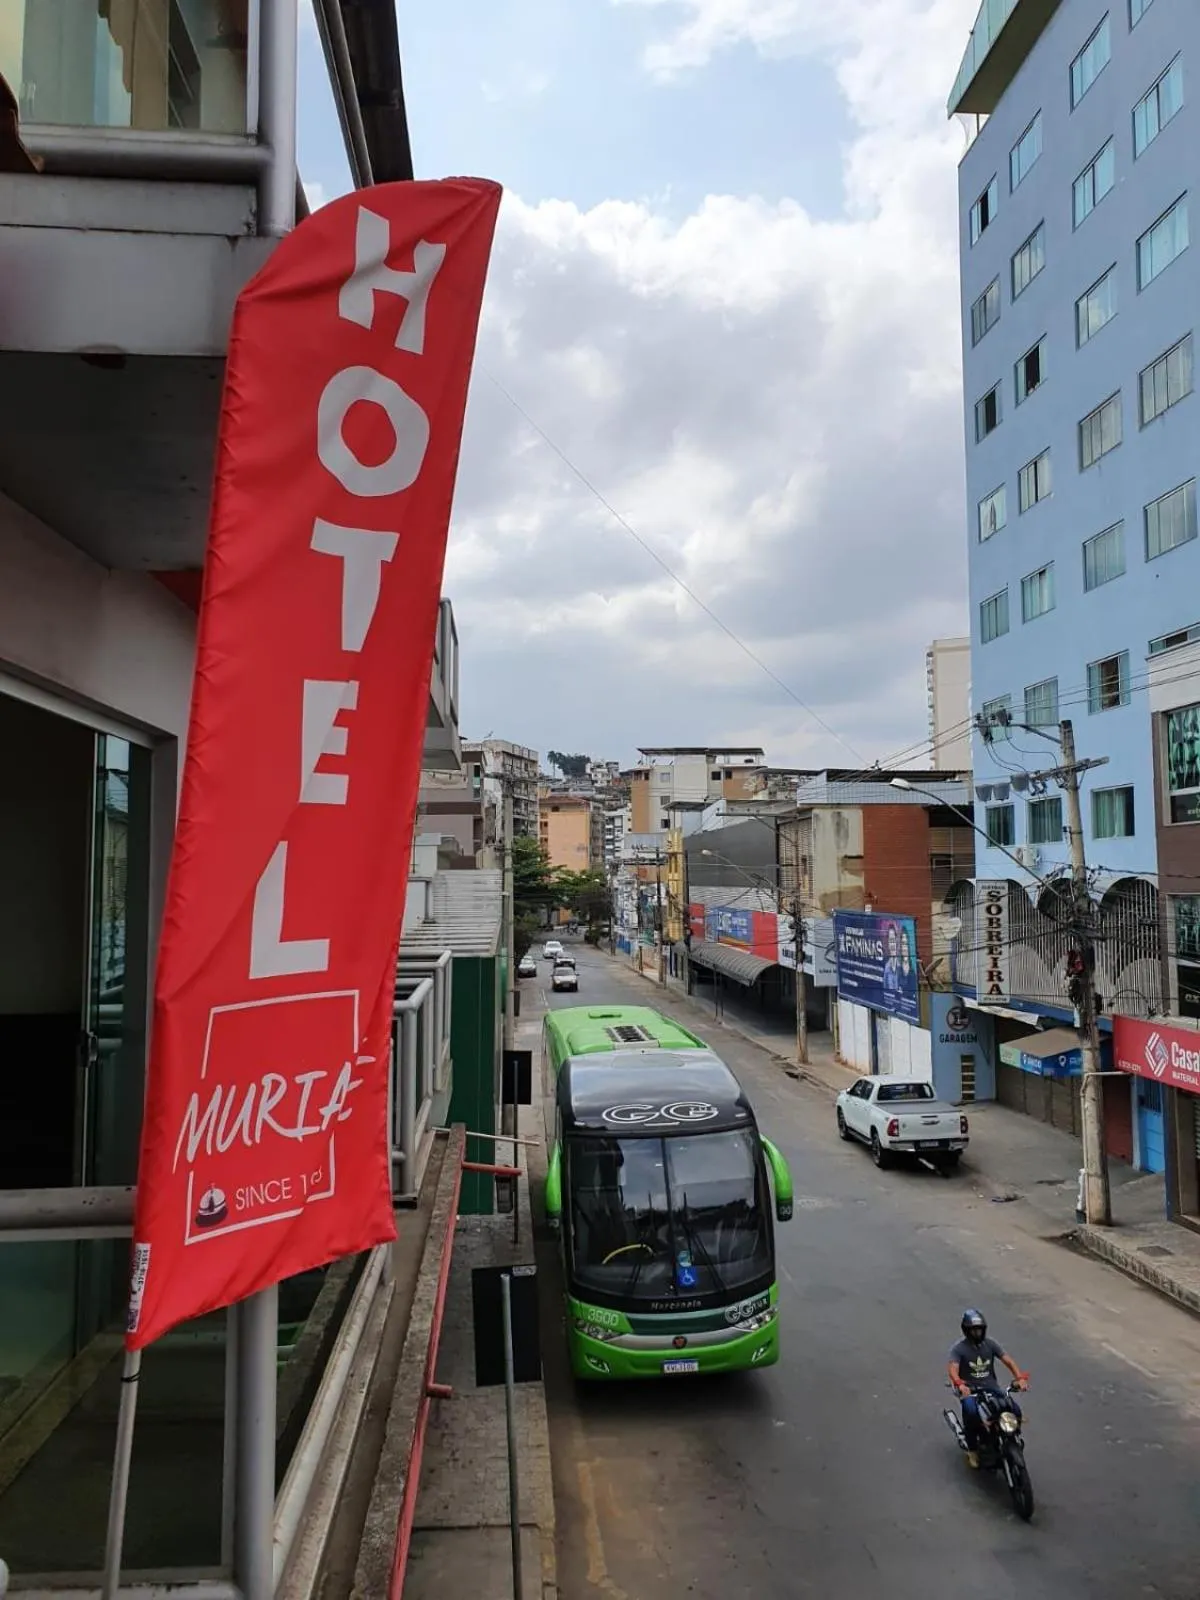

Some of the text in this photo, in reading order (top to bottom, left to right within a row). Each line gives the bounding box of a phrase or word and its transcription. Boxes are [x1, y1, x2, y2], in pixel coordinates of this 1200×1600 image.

[249, 205, 447, 981] HOTEL
[986, 890, 1004, 995] SOBREIRA
[939, 1033, 978, 1044] GARAGEM
[1171, 1070, 1200, 1086] MATERIAL
[235, 1177, 292, 1210] SINCE
